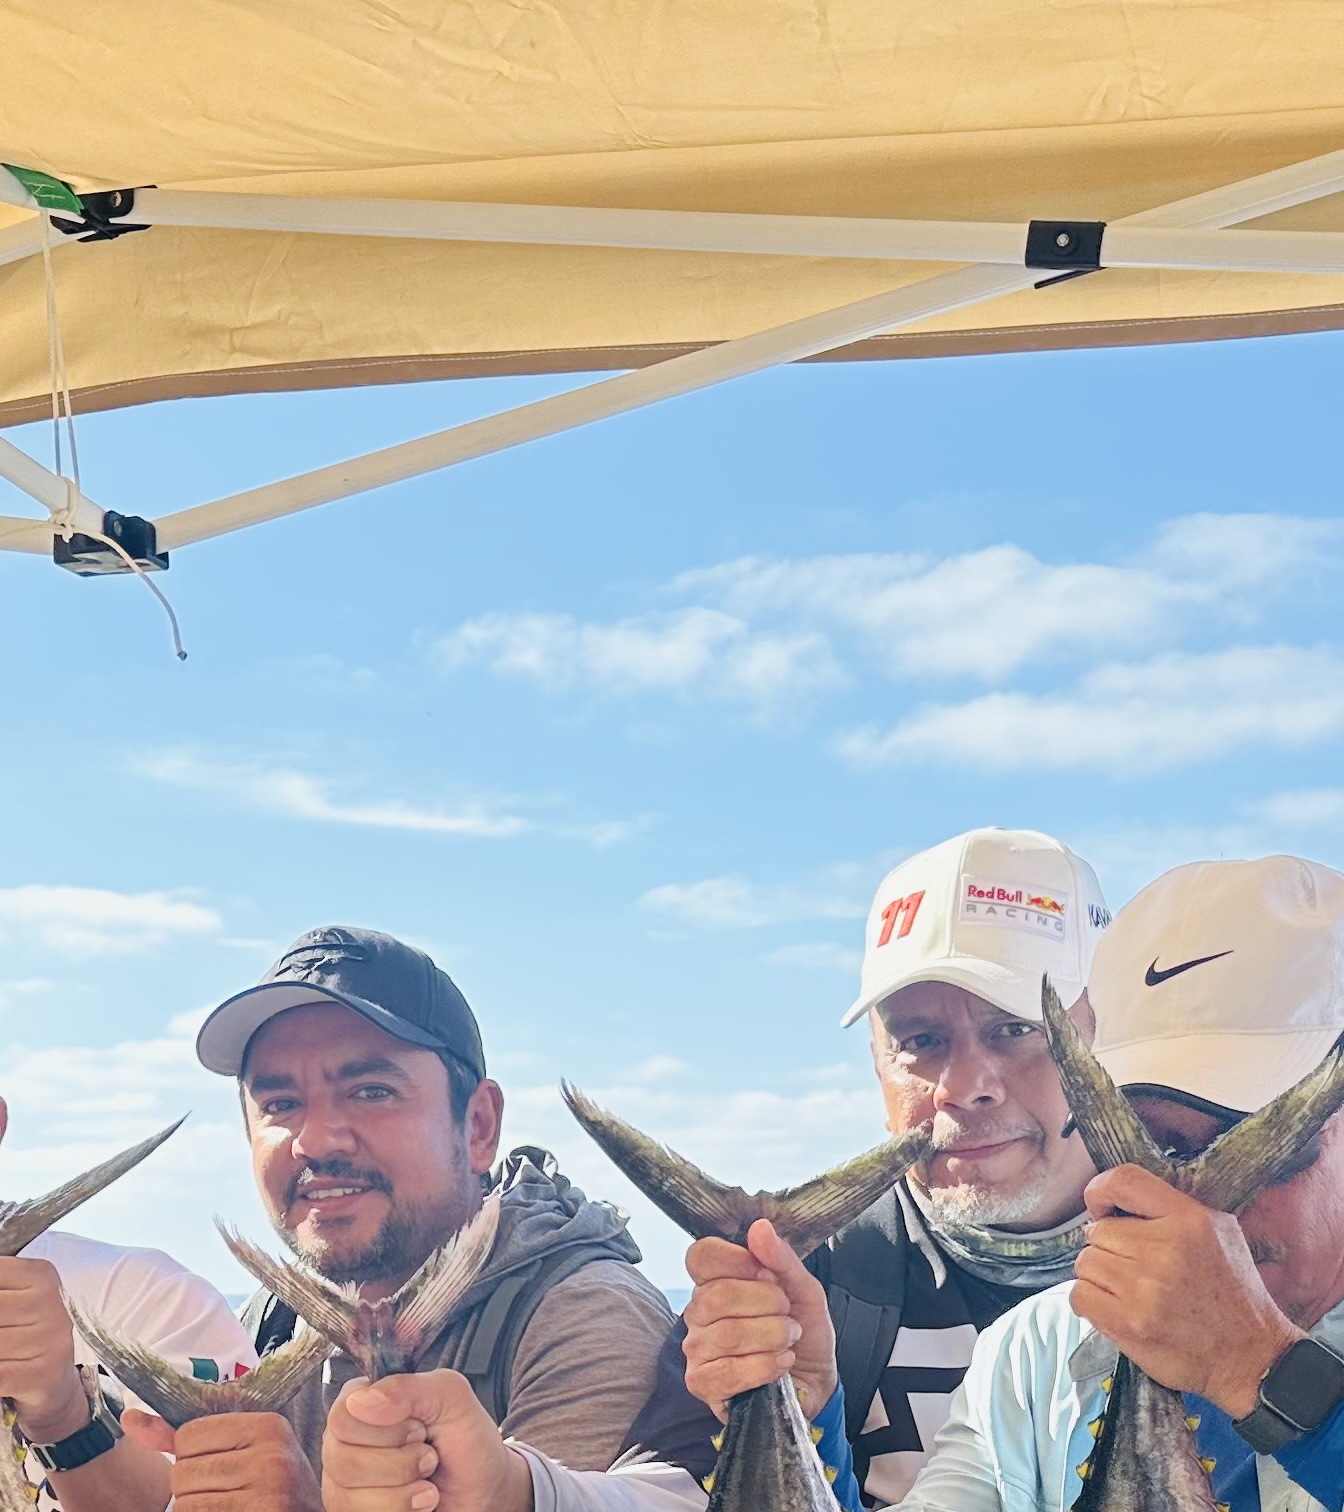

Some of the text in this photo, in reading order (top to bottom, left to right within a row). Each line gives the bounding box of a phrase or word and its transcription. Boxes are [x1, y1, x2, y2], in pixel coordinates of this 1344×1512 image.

[967, 884, 1023, 904] Red Bull
[876, 889, 926, 948] 11
[965, 903, 1064, 933] RACING
